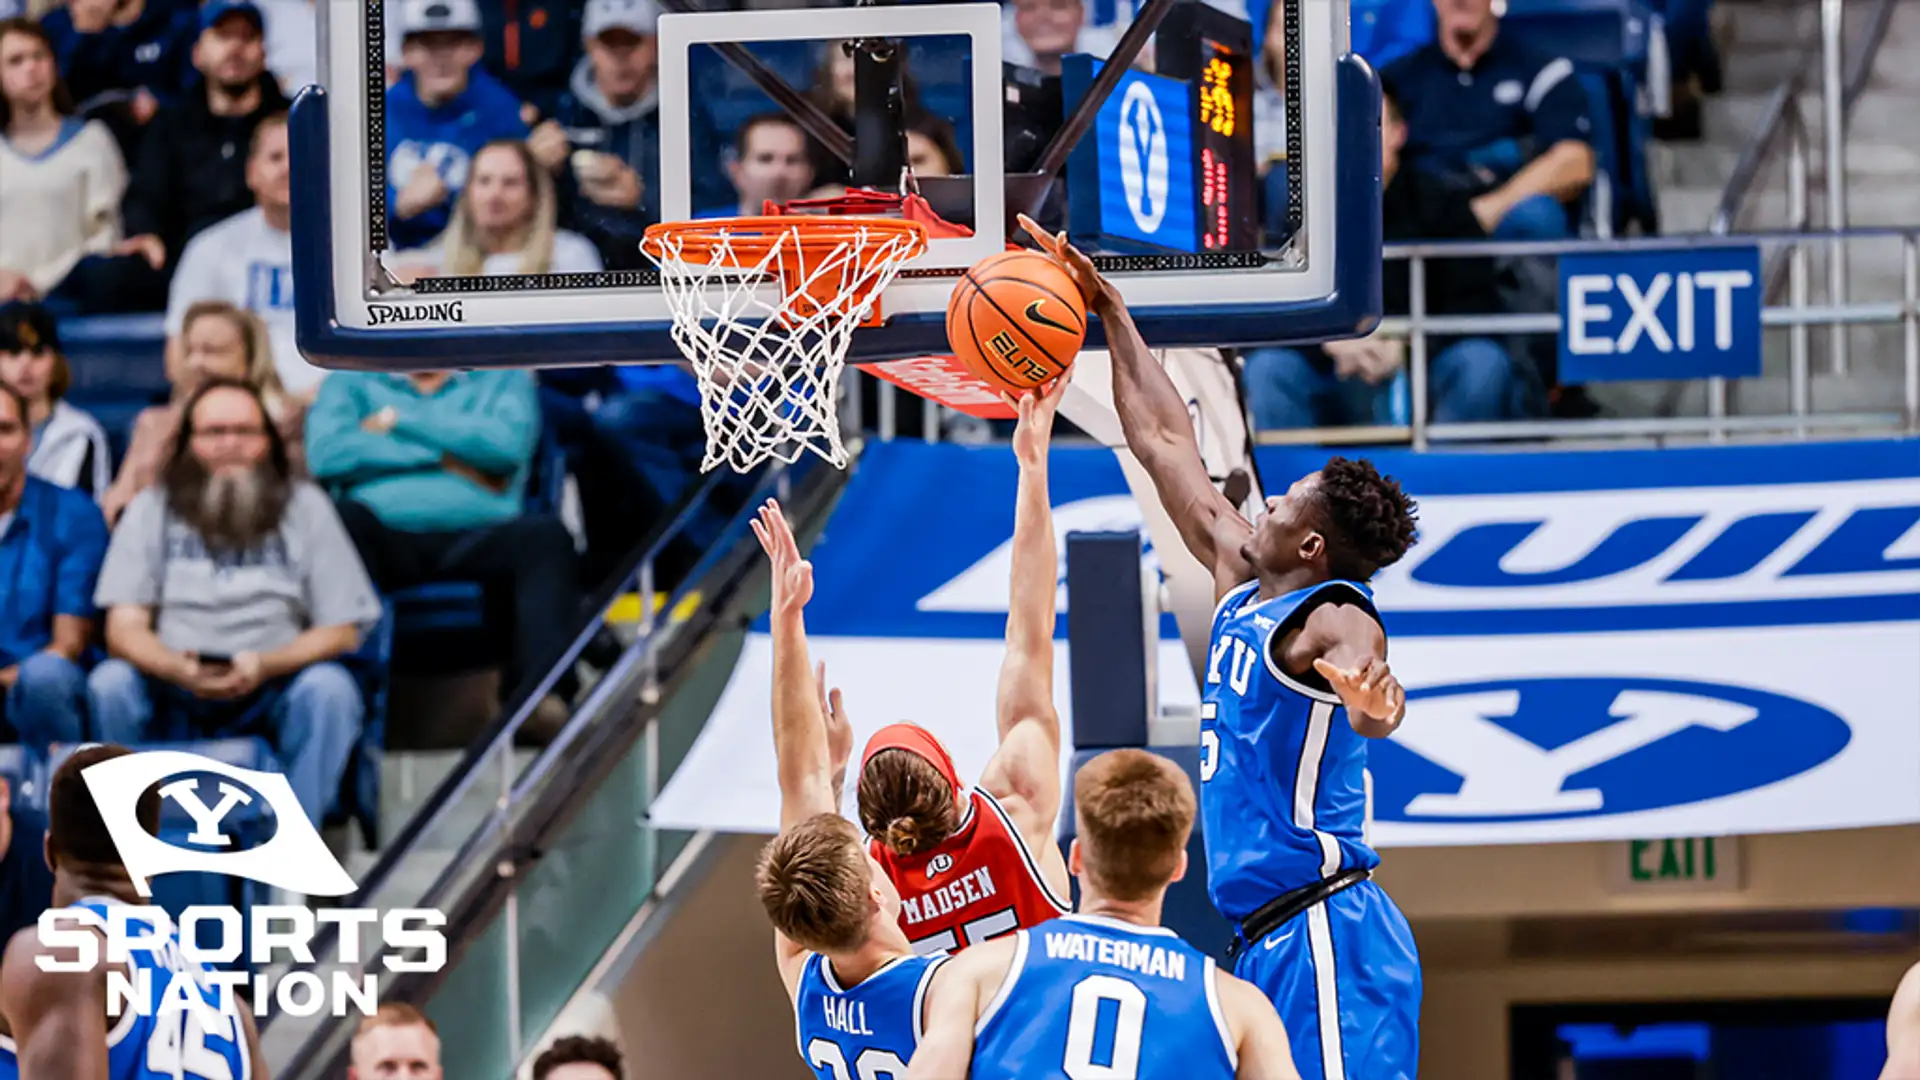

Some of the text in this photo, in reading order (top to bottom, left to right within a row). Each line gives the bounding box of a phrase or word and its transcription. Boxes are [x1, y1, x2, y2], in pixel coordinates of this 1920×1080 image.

[367, 301, 463, 326] SPALDING
[1567, 270, 1752, 354] EXIT
[991, 330, 1049, 382] ELITE
[1380, 506, 1920, 588] UIL
[901, 865, 996, 925] MADSEN
[1045, 932, 1185, 981] WATERMAN
[823, 995, 873, 1035] HALL
[1062, 974, 1147, 1080] 0
